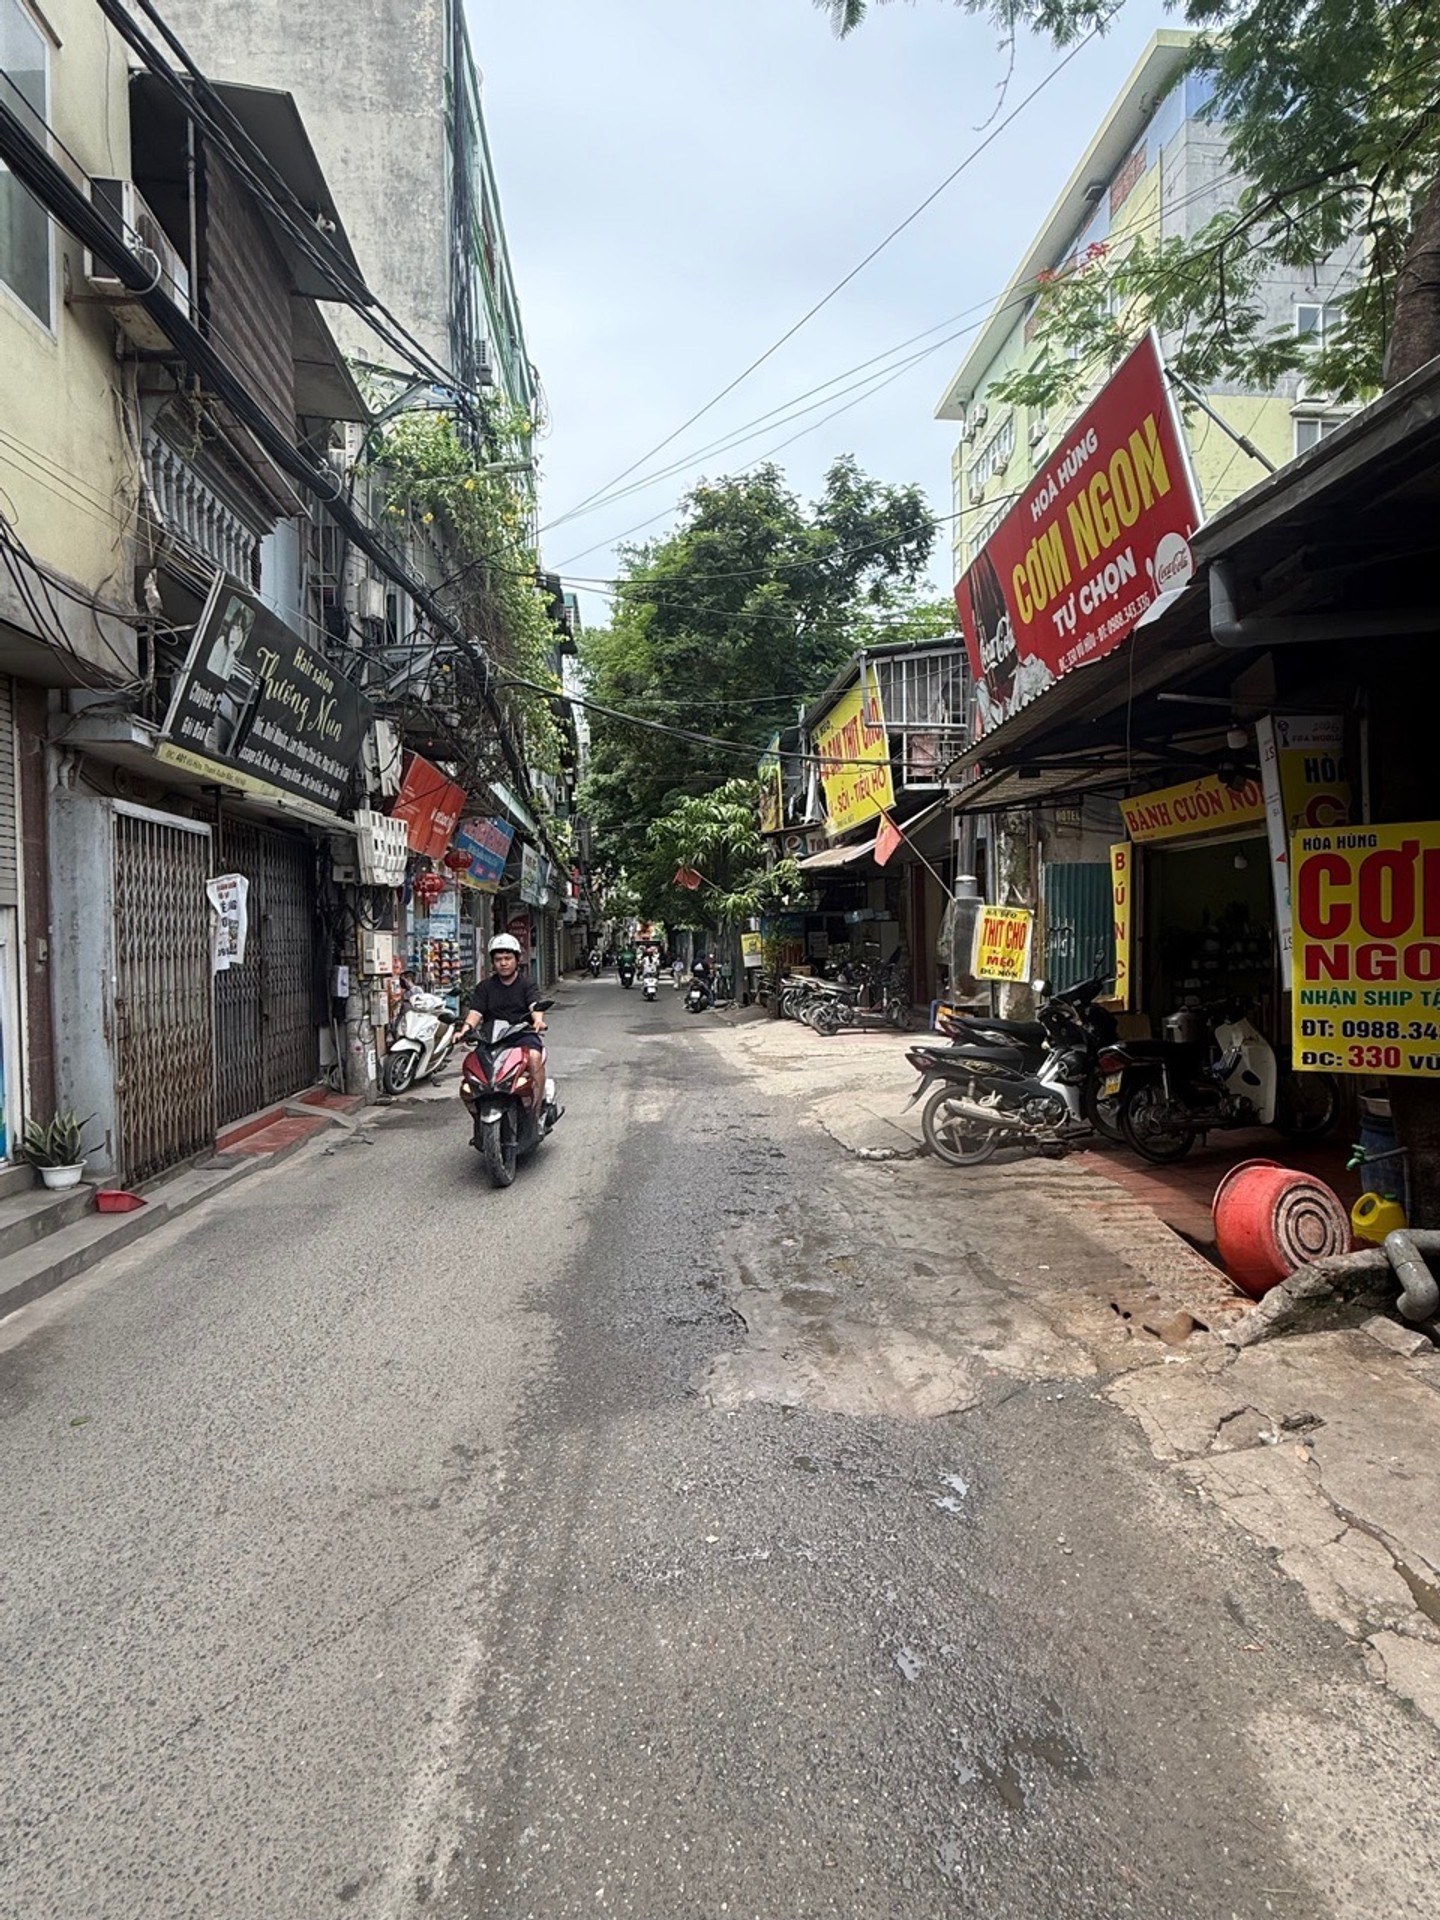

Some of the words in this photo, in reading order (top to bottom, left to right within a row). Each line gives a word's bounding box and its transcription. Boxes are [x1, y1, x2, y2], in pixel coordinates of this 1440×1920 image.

[1030, 474, 1059, 522] HOÀ
[1057, 428, 1099, 488] HÙNG
[1012, 520, 1073, 625] CƠM
[1066, 414, 1172, 571] NGON
[1052, 591, 1077, 637] TỰ
[1079, 546, 1138, 615] CHỌN
[292, 646, 315, 677] Hair
[311, 668, 335, 695] salon
[1125, 802, 1173, 832] BÁNH
[1173, 780, 1225, 823] CUỐN
[1302, 834, 1332, 851] HÒA
[1336, 832, 1378, 849] HÙNG
[1298, 840, 1440, 941] CƠ
[1300, 987, 1357, 1008] NHẬN
[1363, 990, 1413, 1007] SHIP
[1301, 1019, 1335, 1038] ĐT:
[1341, 1019, 1440, 1041] 0988.34
[1301, 1051, 1342, 1067] ĐC:
[1348, 1045, 1402, 1069] 330
